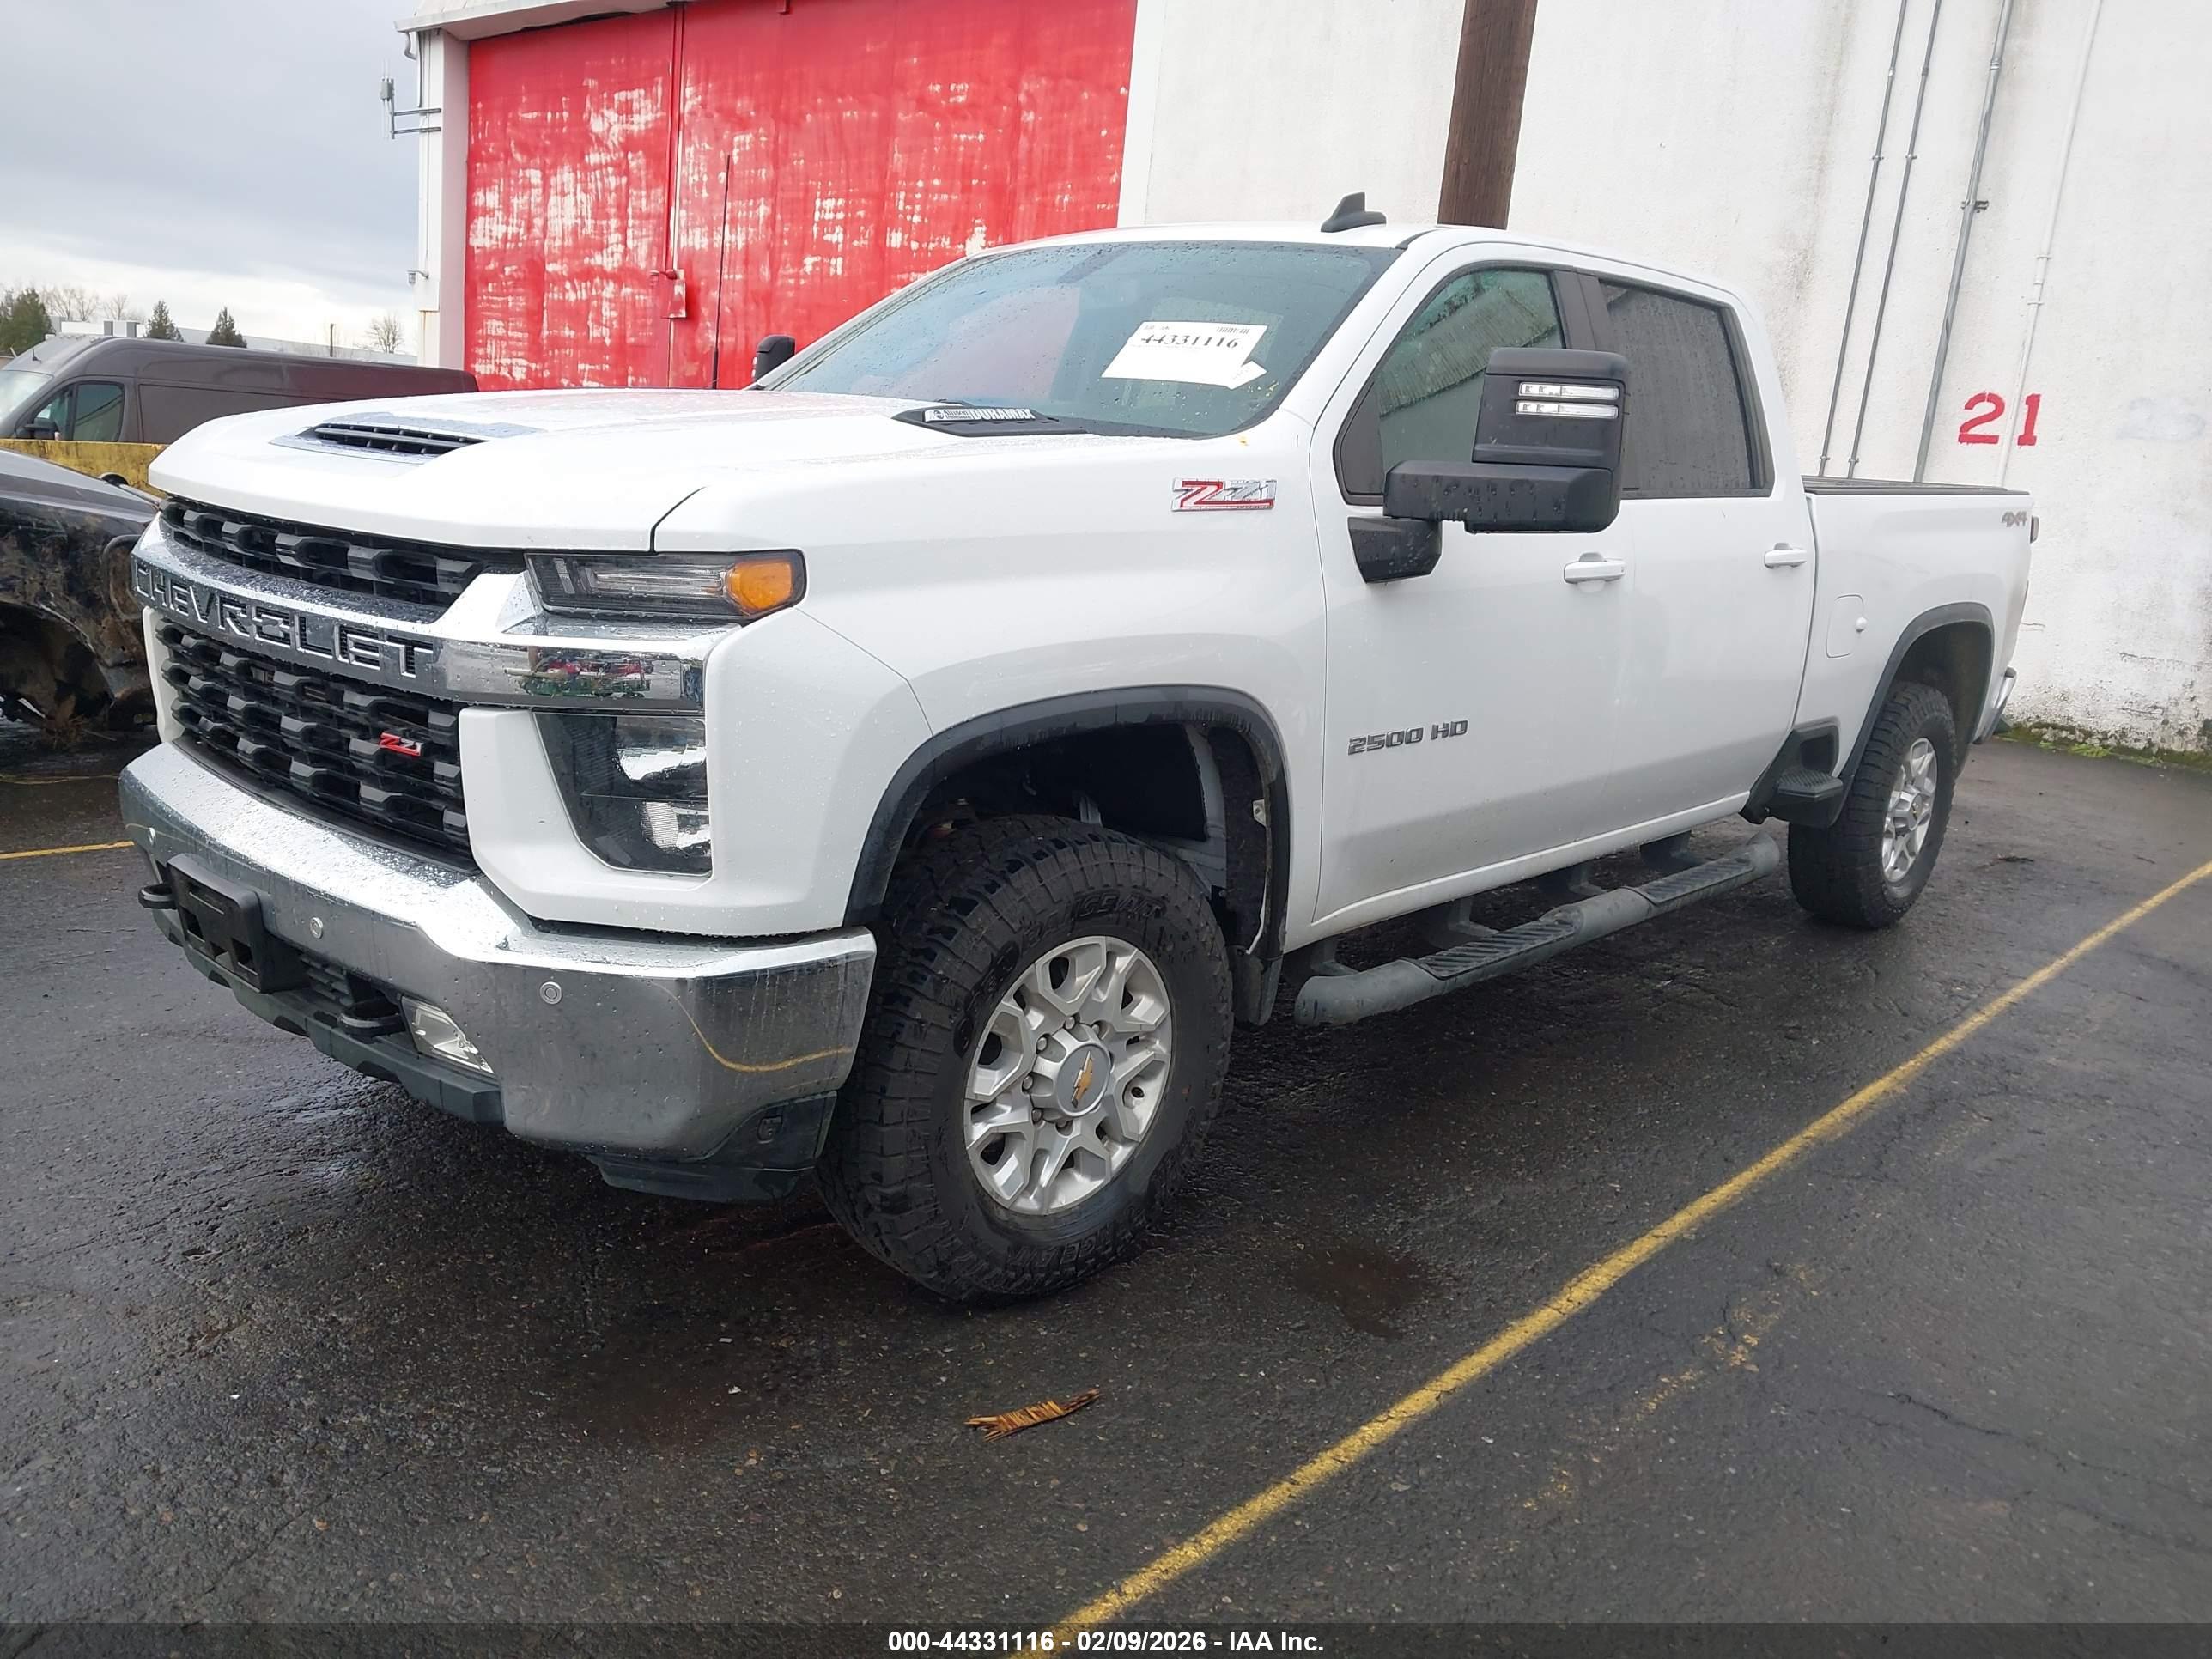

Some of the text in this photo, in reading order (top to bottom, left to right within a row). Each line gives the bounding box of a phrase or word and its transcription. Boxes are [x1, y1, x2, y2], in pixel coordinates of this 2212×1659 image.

[1141, 334, 1240, 349] 44331116
[1958, 392, 2041, 446] 21
[1171, 478, 1277, 512] Z71
[133, 559, 434, 678] CHEVROLET
[1347, 720, 1469, 756] 2500 HD
